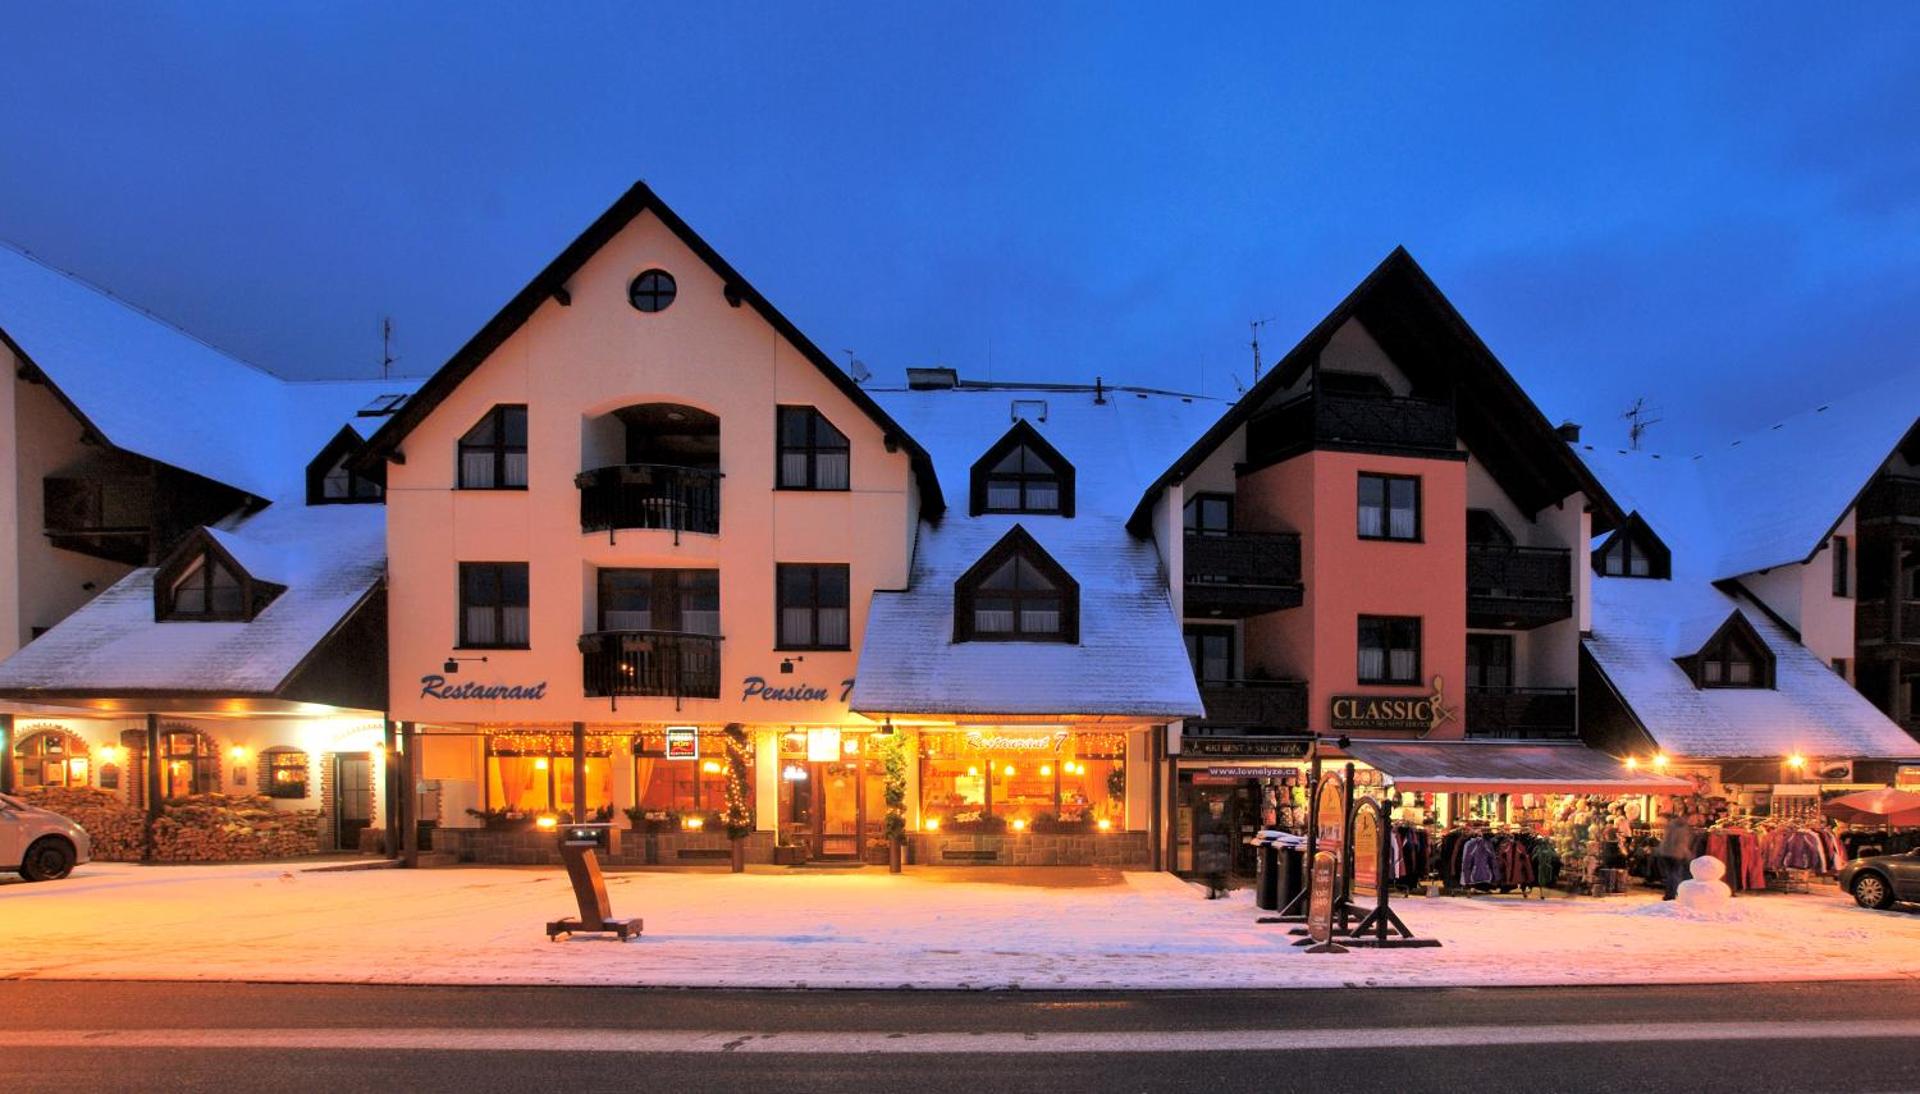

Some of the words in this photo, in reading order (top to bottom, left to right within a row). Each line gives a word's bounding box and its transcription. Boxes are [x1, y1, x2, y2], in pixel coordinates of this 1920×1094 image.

[420, 675, 547, 700] Restaurant
[742, 676, 828, 702] Pension
[840, 678, 857, 702] 7
[1333, 699, 1431, 720] CLASSIC
[966, 731, 1050, 750] Restaurant
[1054, 731, 1068, 752] 7
[1209, 767, 1297, 777] www.lovnelyze.cz
